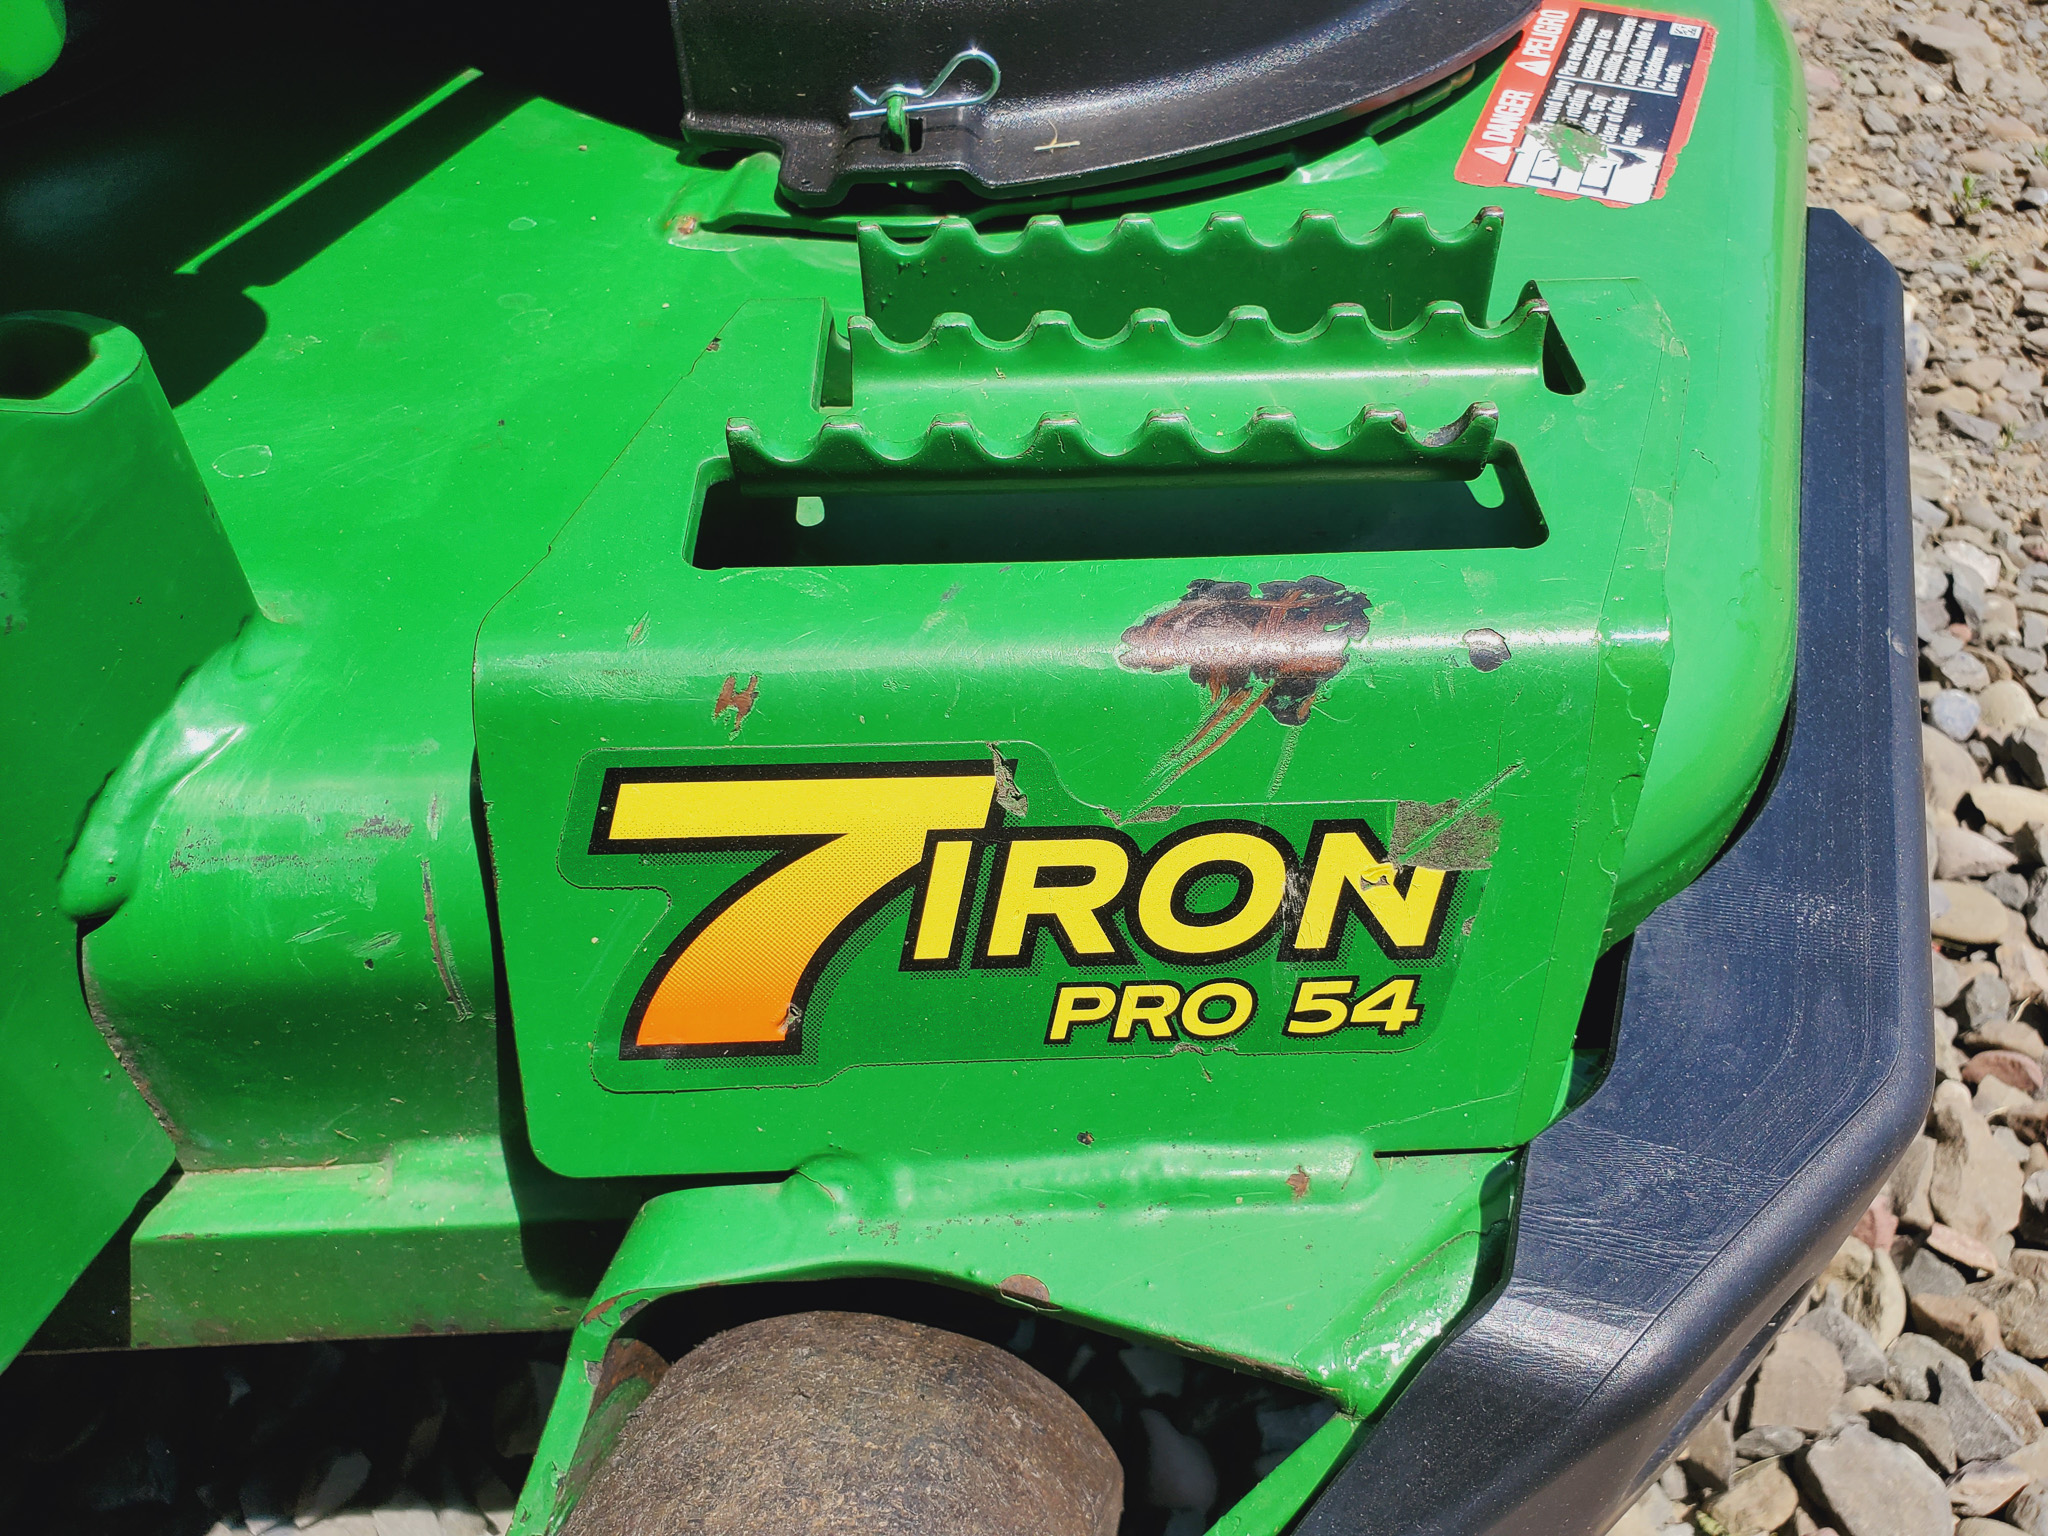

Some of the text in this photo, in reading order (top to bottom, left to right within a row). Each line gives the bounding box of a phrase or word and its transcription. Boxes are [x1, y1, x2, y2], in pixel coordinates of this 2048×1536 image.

[1522, 8, 1570, 58] PELIGRO
[1560, 60, 1580, 76] Para
[1550, 79, 1575, 101] injury
[1566, 89, 1593, 118] rotating
[1589, 95, 1611, 111] stay
[1482, 88, 1534, 143] DANGER
[1541, 100, 1563, 121] avoid
[1600, 96, 1629, 143] clear of deck
[599, 768, 1453, 1053] 7 IRON
[1048, 978, 1419, 1041] PRO 54
